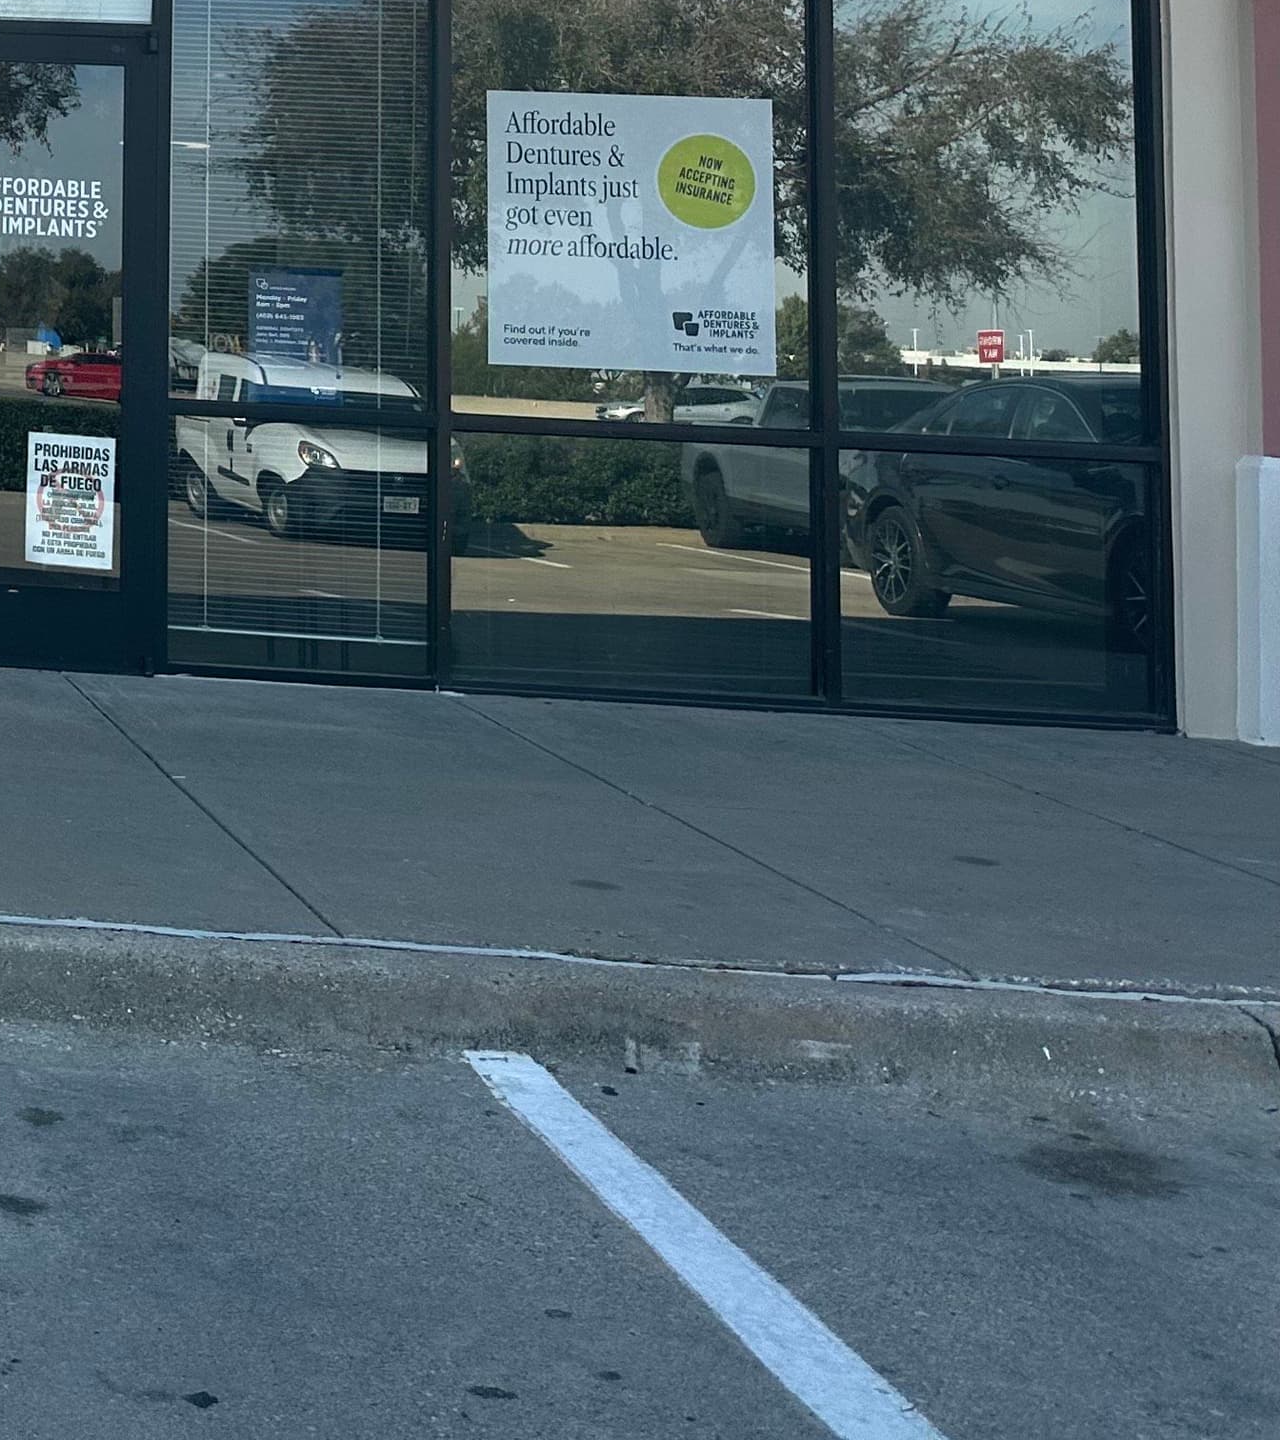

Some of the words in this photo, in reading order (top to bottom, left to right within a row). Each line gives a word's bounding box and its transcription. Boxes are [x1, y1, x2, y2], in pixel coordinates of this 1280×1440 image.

[505, 111, 616, 137] Affordable
[506, 141, 601, 167] Dentures
[608, 144, 625, 168] &
[699, 155, 722, 170] NOW
[506, 172, 597, 201] Implants
[599, 175, 639, 203] just
[678, 166, 735, 190] ACCEPTING
[675, 181, 733, 205] INSURANCE
[93, 200, 109, 219] &
[505, 206, 539, 231] got
[544, 209, 593, 227] even
[507, 238, 564, 256] more
[567, 234, 678, 261] affordable.
[698, 310, 756, 320] AFFORDABLE
[504, 324, 526, 334] Find
[528, 326, 546, 335] out
[548, 325, 556, 336] if
[557, 327, 590, 338] you're
[703, 320, 751, 330] DENTURES
[709, 329, 755, 339] IMPLANTS
[503, 336, 546, 346] covered
[673, 343, 702, 353] That's
[704, 343, 728, 353] what
[745, 346, 760, 355] do.
[34, 443, 110, 462] PROHIBIDAS
[34, 458, 58, 473] LAS
[62, 460, 109, 477] ARMAS
[40, 474, 56, 488] DE
[60, 476, 102, 492] FUEGO
